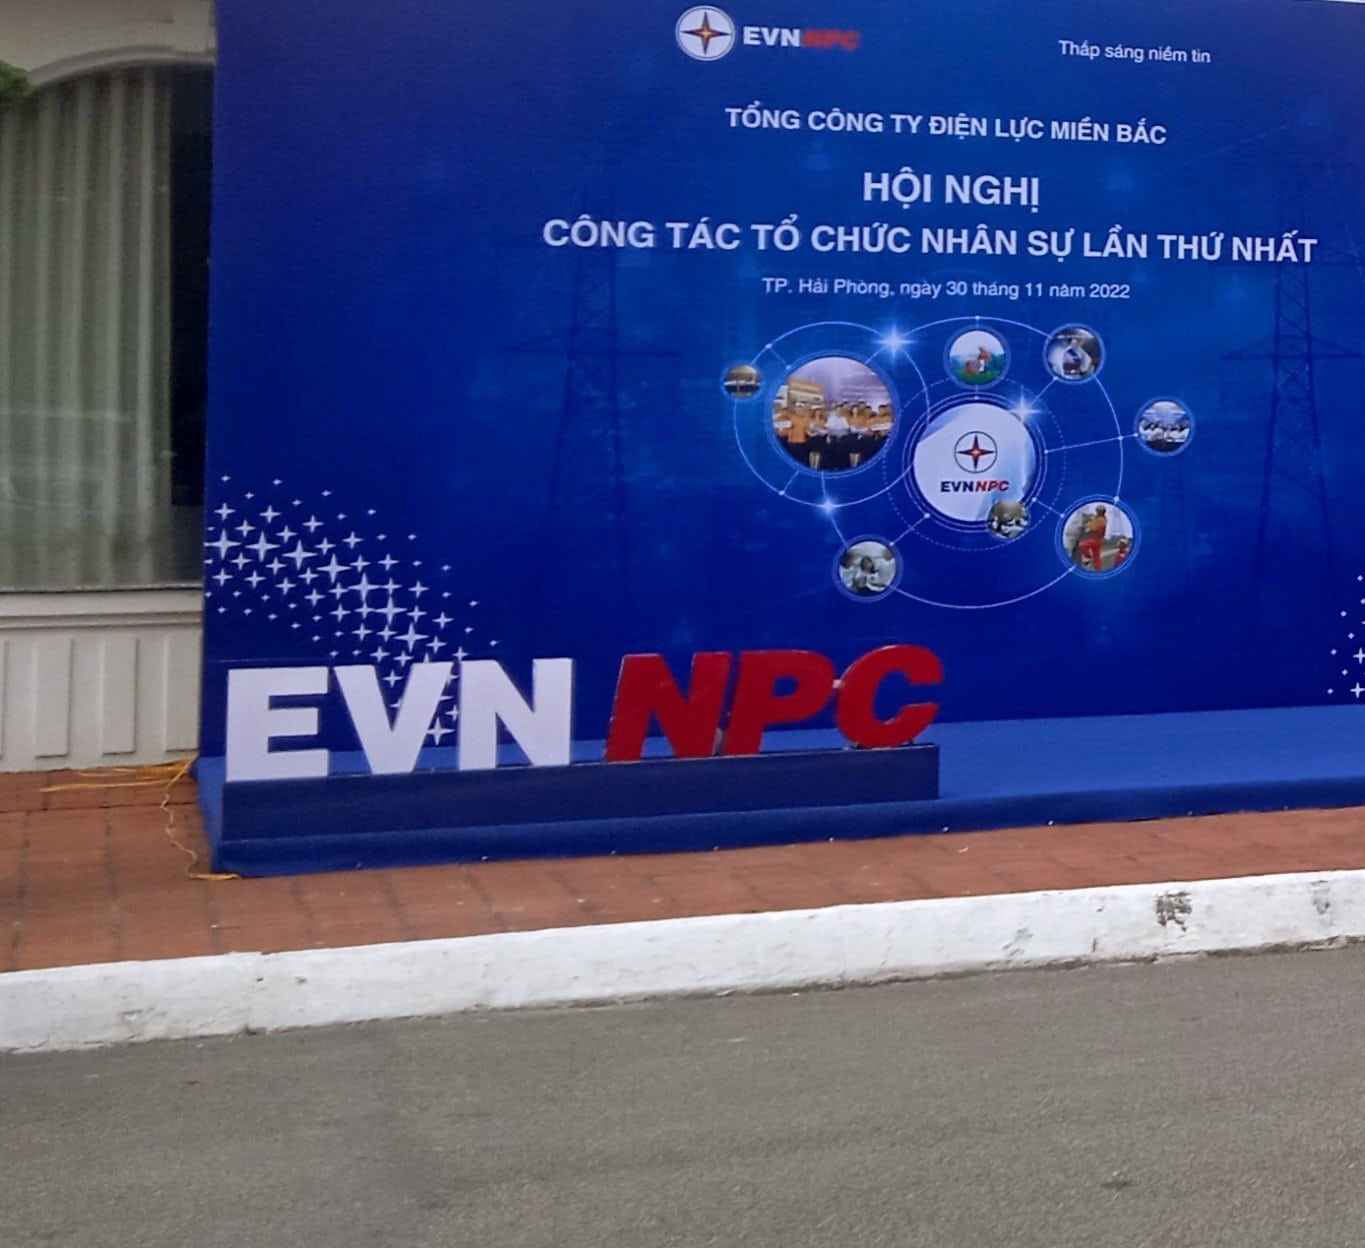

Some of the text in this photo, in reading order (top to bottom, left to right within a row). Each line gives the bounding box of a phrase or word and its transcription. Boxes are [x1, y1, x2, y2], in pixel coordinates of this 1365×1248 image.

[1058, 40, 1210, 63] Thắp sáng niềm tin
[725, 101, 1166, 144] TỔNG CÔNG TY ĐIỆN LỰC MIỀN BẮC
[864, 167, 1038, 212] HỘI NGHỊ
[543, 214, 1317, 262] CÔNG TÁC TỔ CHỨC NHÂN SỰ LẦN THỨ NHẤT
[762, 278, 1130, 300] TP. Hải Phòng, ngày 30 tháng 11 năm 2022
[227, 644, 944, 782] EVN NPC
